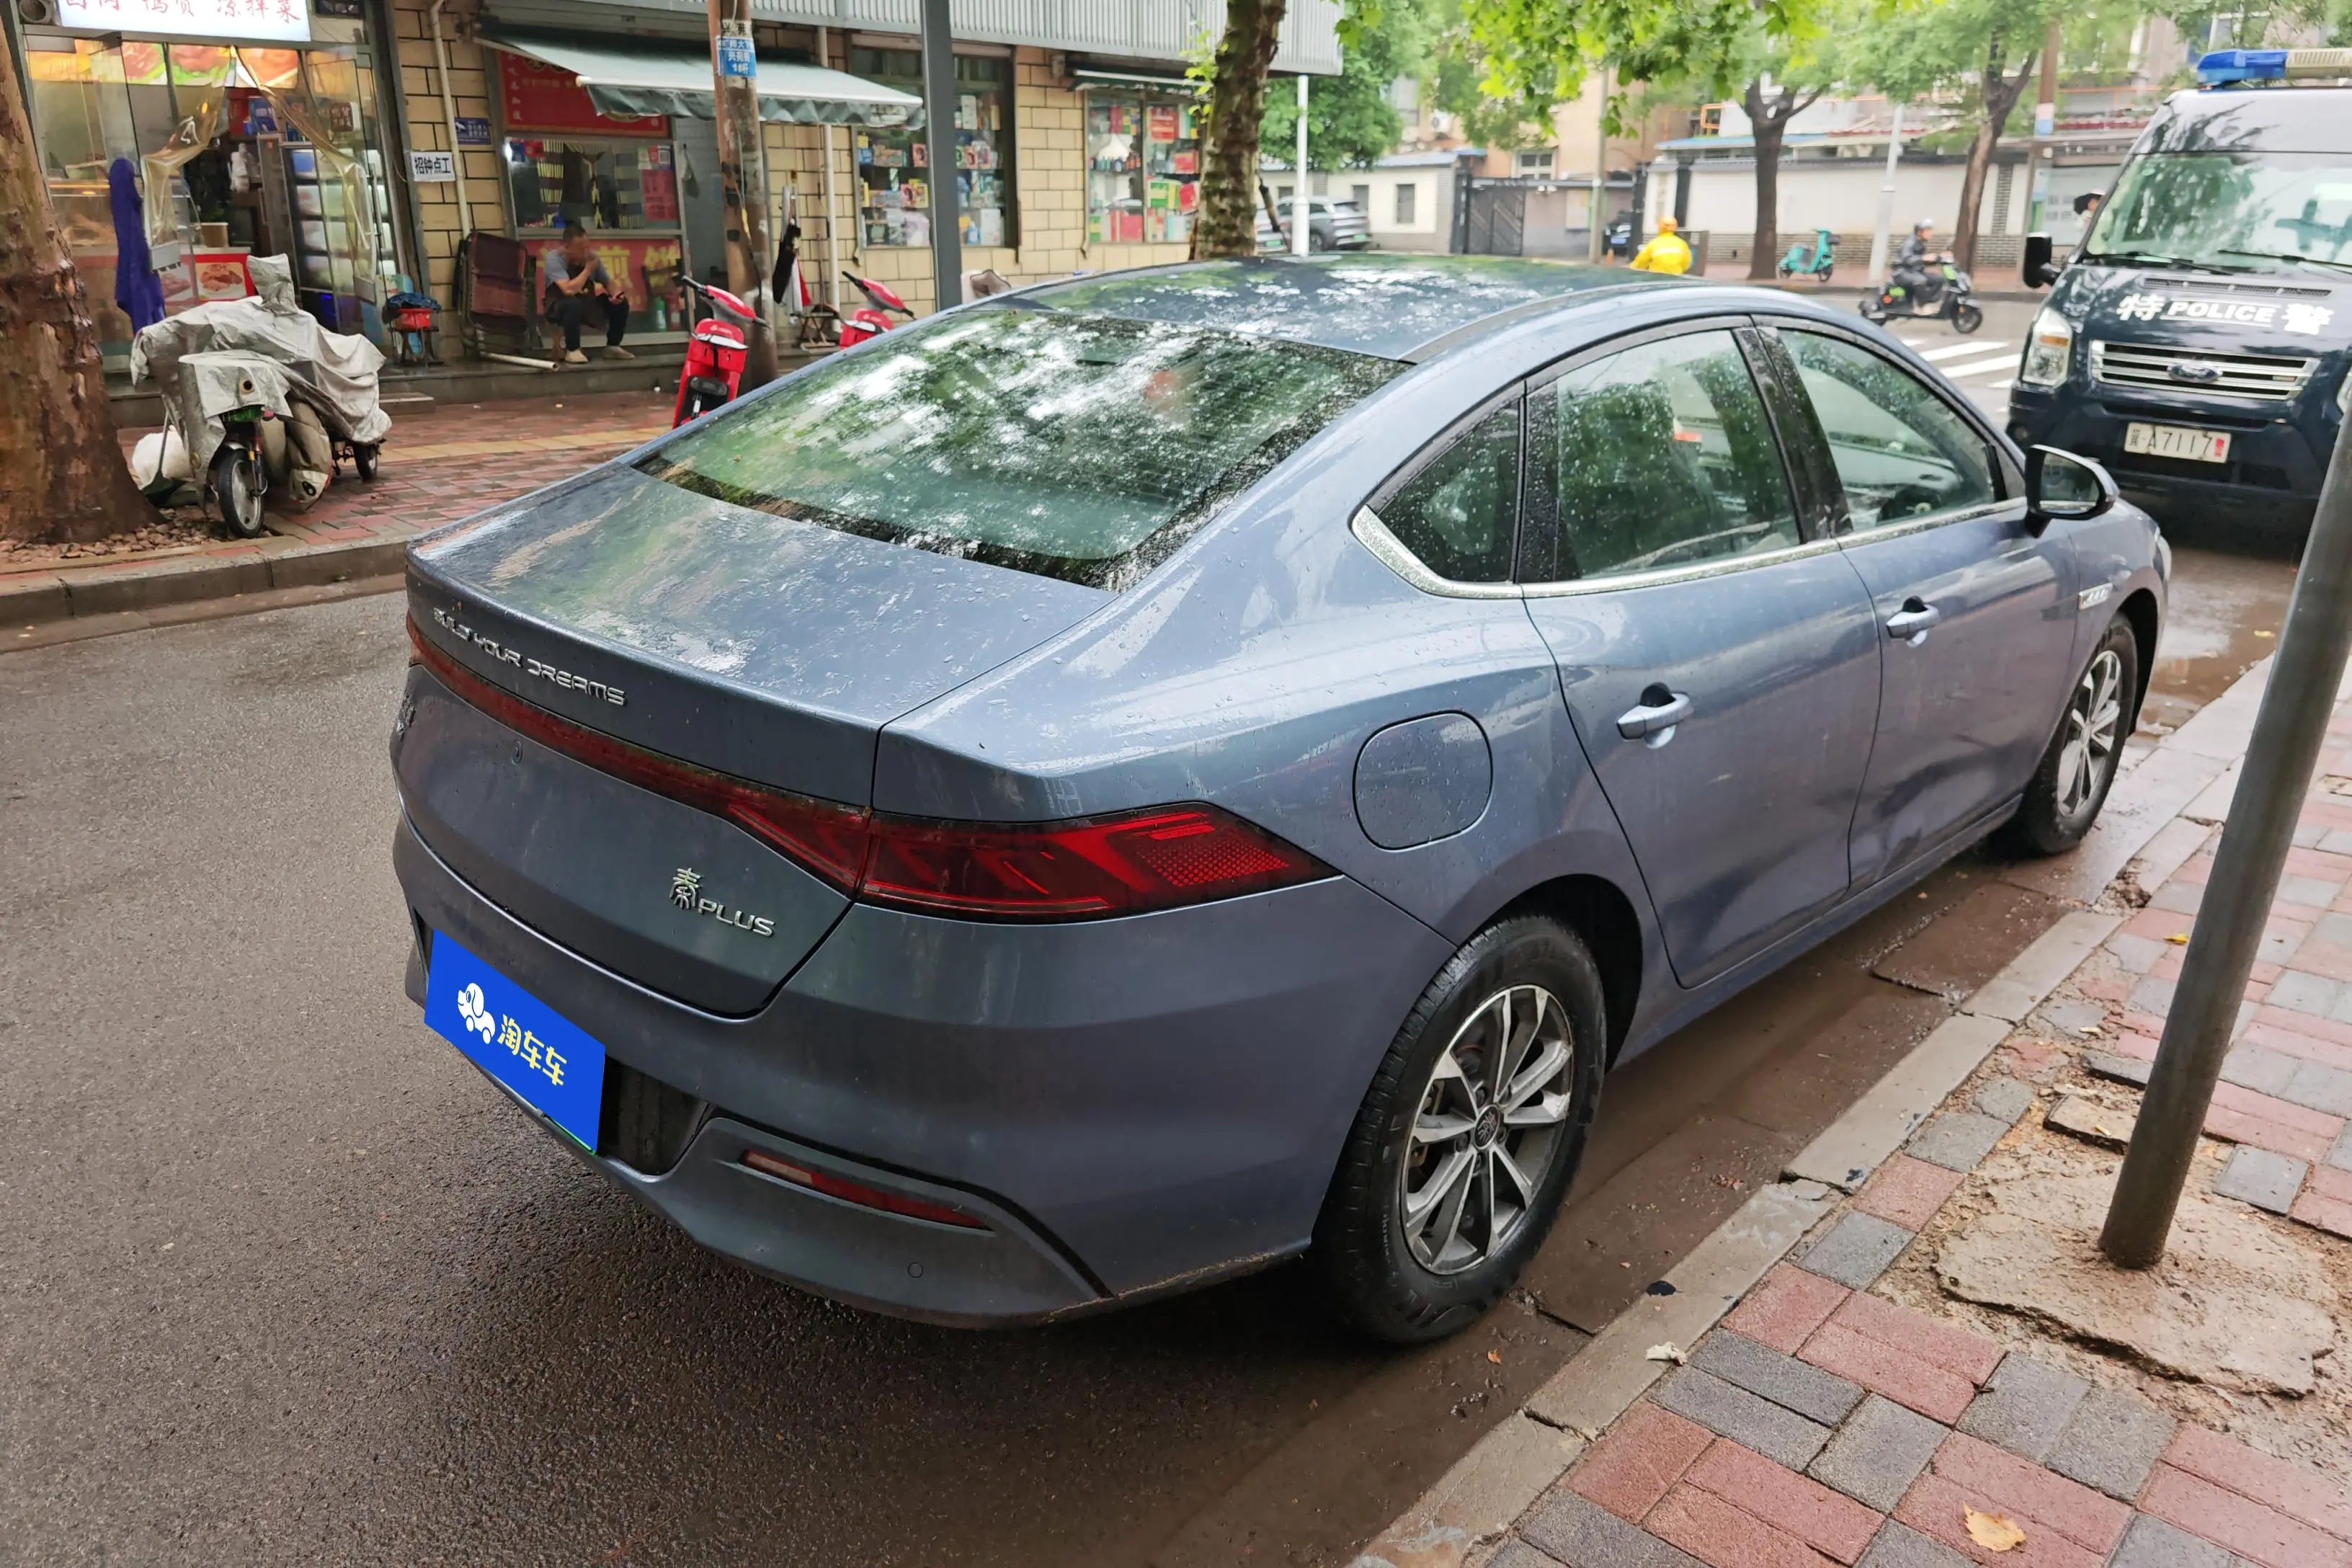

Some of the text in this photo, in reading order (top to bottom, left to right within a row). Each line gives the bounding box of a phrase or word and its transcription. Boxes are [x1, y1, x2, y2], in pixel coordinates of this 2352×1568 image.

[414, 156, 451, 174] 招钟点工
[2116, 293, 2166, 321] 特
[2167, 300, 2277, 324] POLICE
[473, 632, 523, 668] YOUR
[527, 658, 626, 706] DREAMS
[698, 898, 776, 937] PLUS
